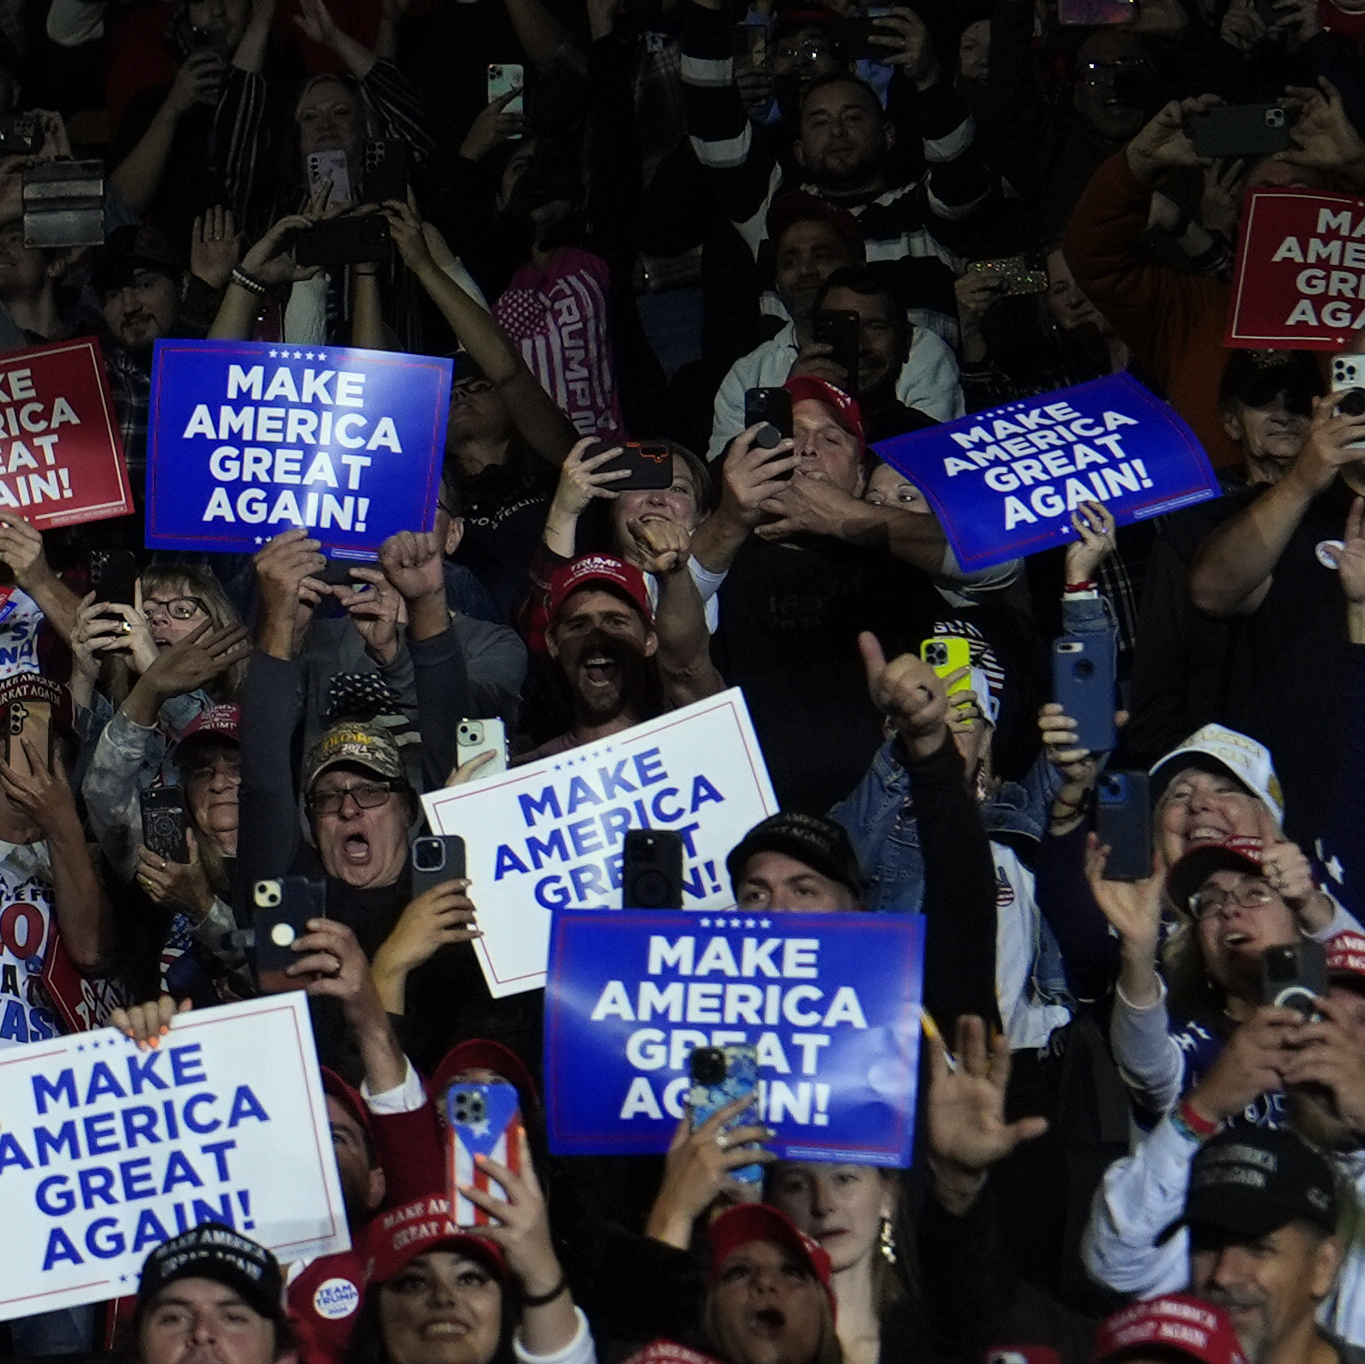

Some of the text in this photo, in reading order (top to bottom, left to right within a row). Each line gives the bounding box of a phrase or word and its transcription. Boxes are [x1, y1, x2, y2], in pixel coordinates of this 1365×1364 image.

[226, 365, 366, 408] MAKE
[184, 405, 403, 454] AMERICA
[943, 409, 1139, 477] AMERICA
[952, 401, 1082, 448] MAKE
[209, 448, 371, 490] GREAT
[984, 437, 1130, 494] GREAT
[202, 488, 370, 533] AGAIN!
[1004, 459, 1155, 531] AGAIN!
[570, 556, 620, 571] TRUMP
[17, 672, 62, 694] AMERICA
[518, 748, 663, 829] MAKE
[494, 775, 724, 883] AMERICA
[0, 965, 21, 995] A
[647, 935, 819, 979] MAKE
[592, 981, 867, 1029] AMERICA
[30, 1044, 207, 1114] MAKE
[36, 1140, 239, 1217] GREAT
[42, 1189, 258, 1271] AGAIN!
[316, 1293, 358, 1307] TRUMP
[319, 1286, 353, 1299] TEAM
